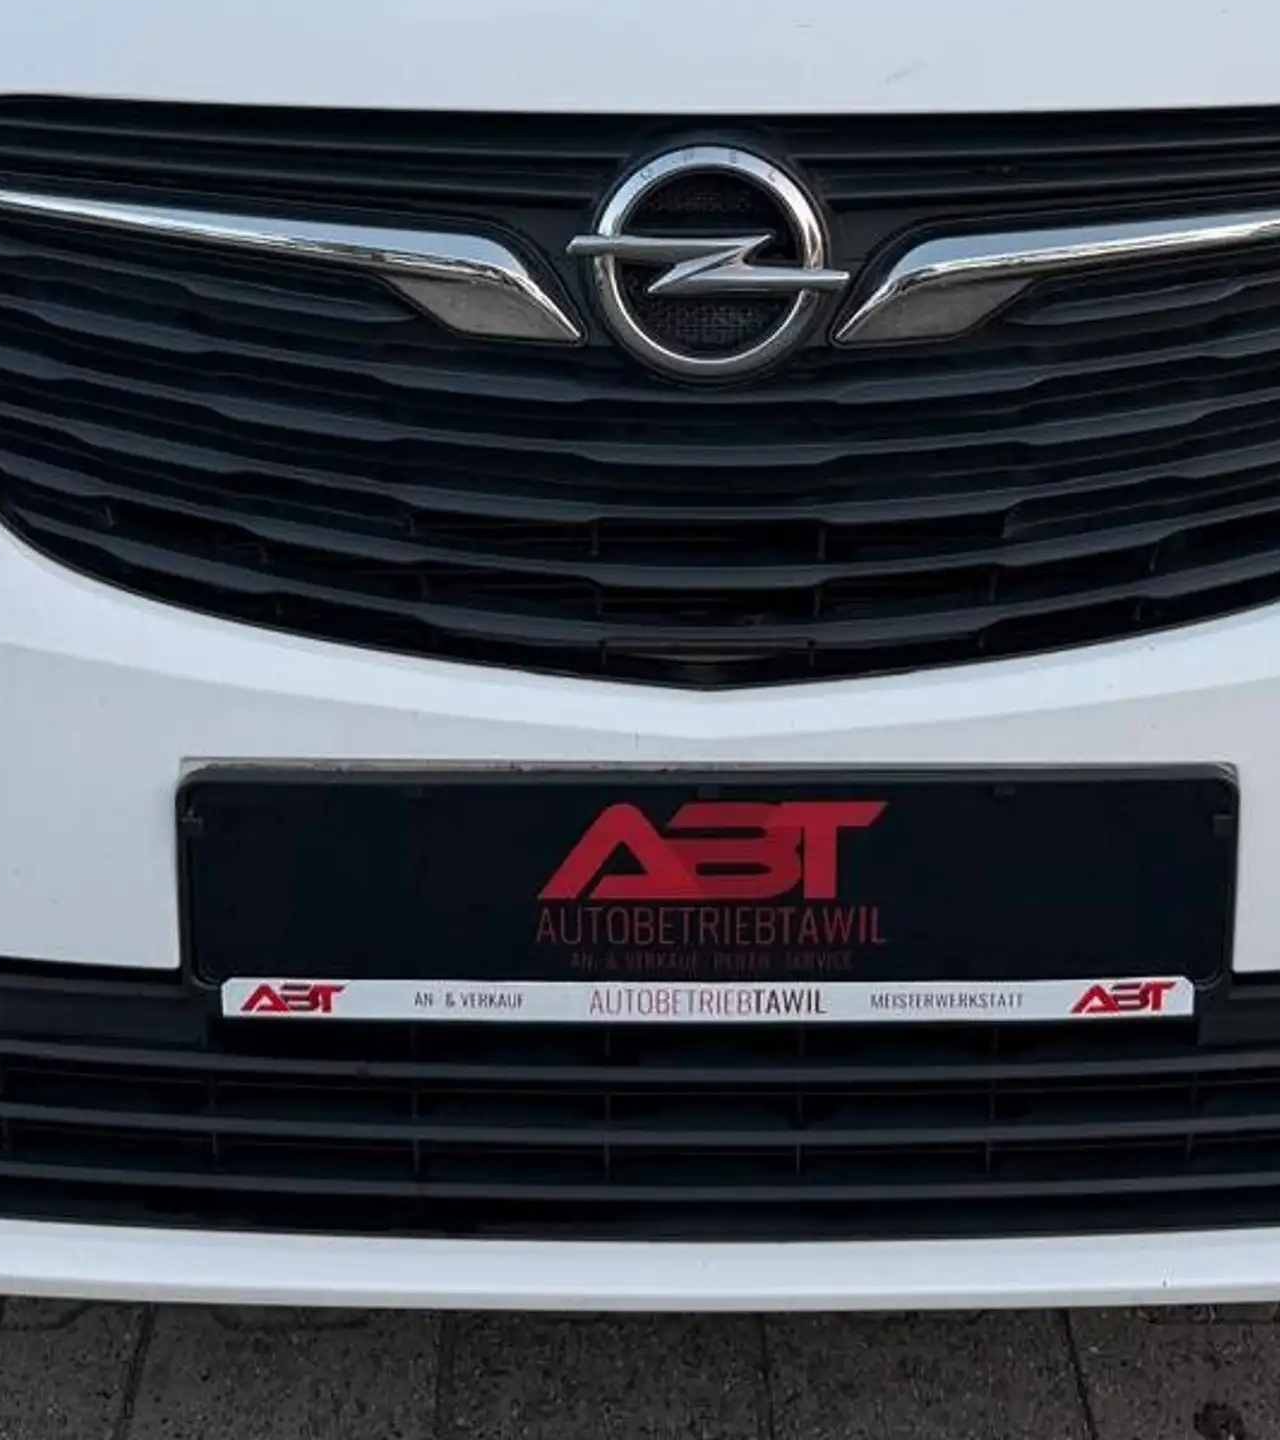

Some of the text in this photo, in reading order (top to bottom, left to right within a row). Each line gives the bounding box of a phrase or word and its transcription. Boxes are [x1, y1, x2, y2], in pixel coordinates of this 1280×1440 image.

[536, 800, 889, 901] ABT
[535, 906, 889, 946] AUTOBETRIEBTAWIL
[240, 984, 347, 1012] ABT
[460, 991, 524, 1009] VERKAUF
[589, 988, 828, 1015] AUTOBETRIEBTAWIL
[869, 991, 1024, 1009] MEISTERWERKSTATT
[1069, 981, 1177, 1014] ABT
